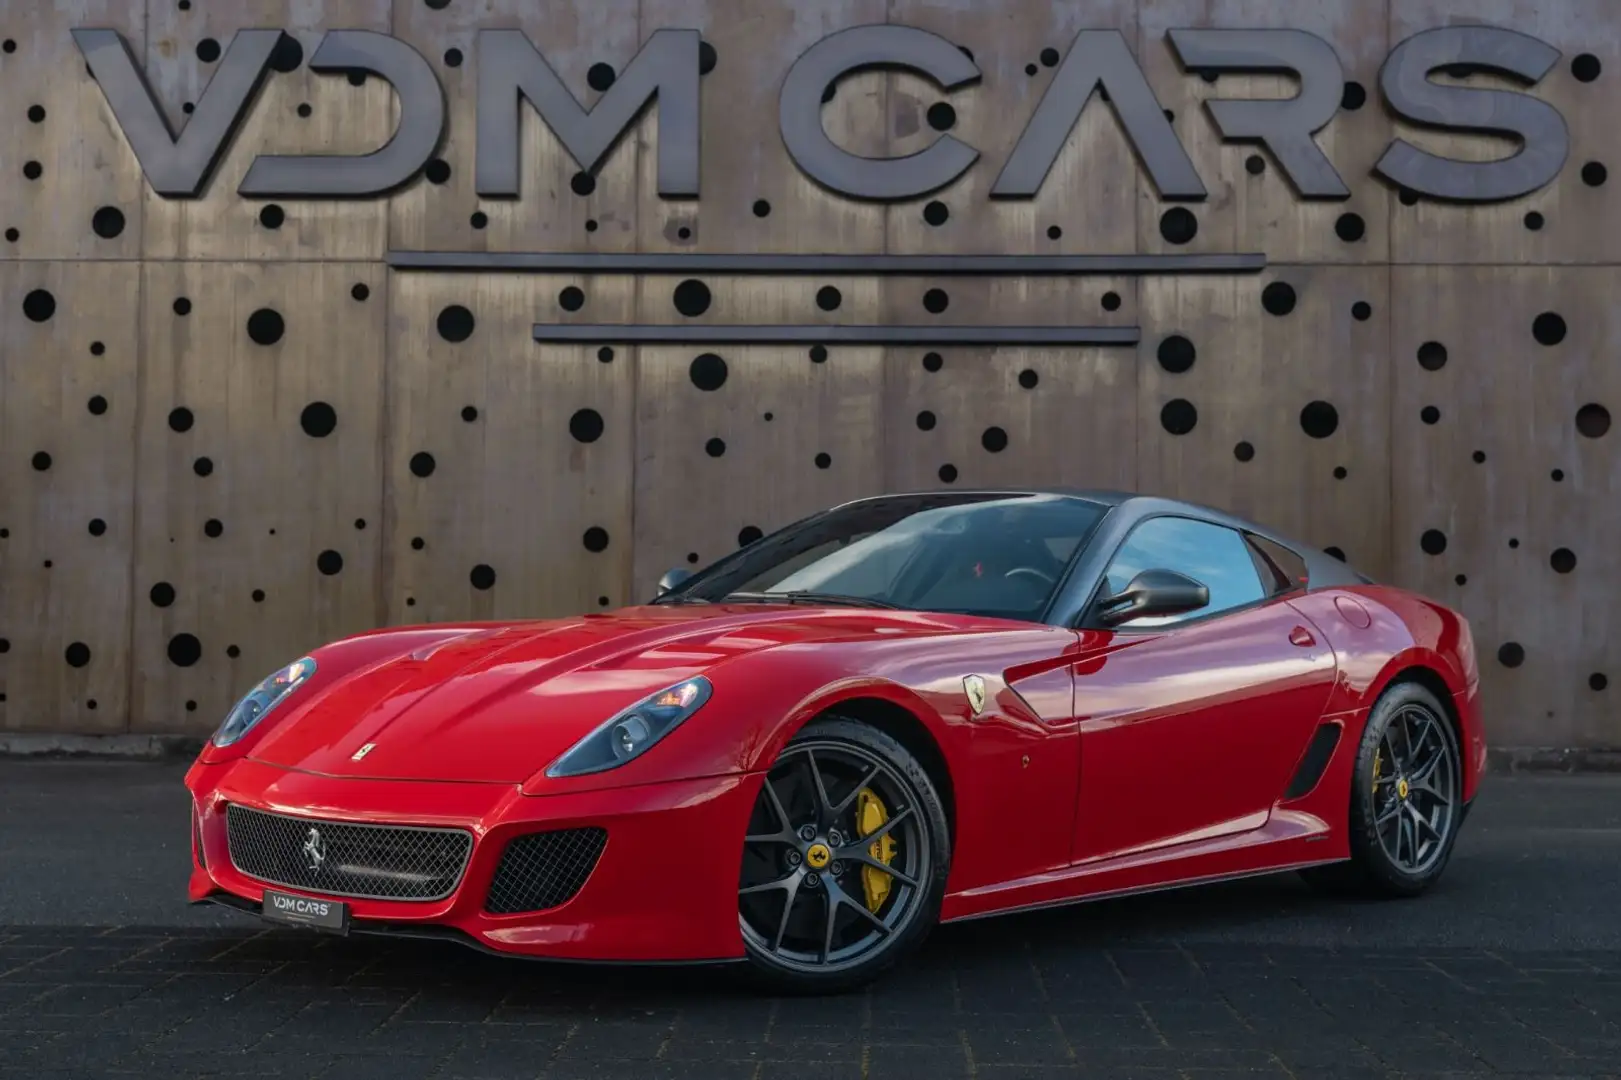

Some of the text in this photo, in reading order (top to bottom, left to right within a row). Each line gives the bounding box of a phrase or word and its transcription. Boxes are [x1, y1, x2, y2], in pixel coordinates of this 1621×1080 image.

[70, 24, 1570, 203] VDM CARS
[273, 895, 295, 911] VDM
